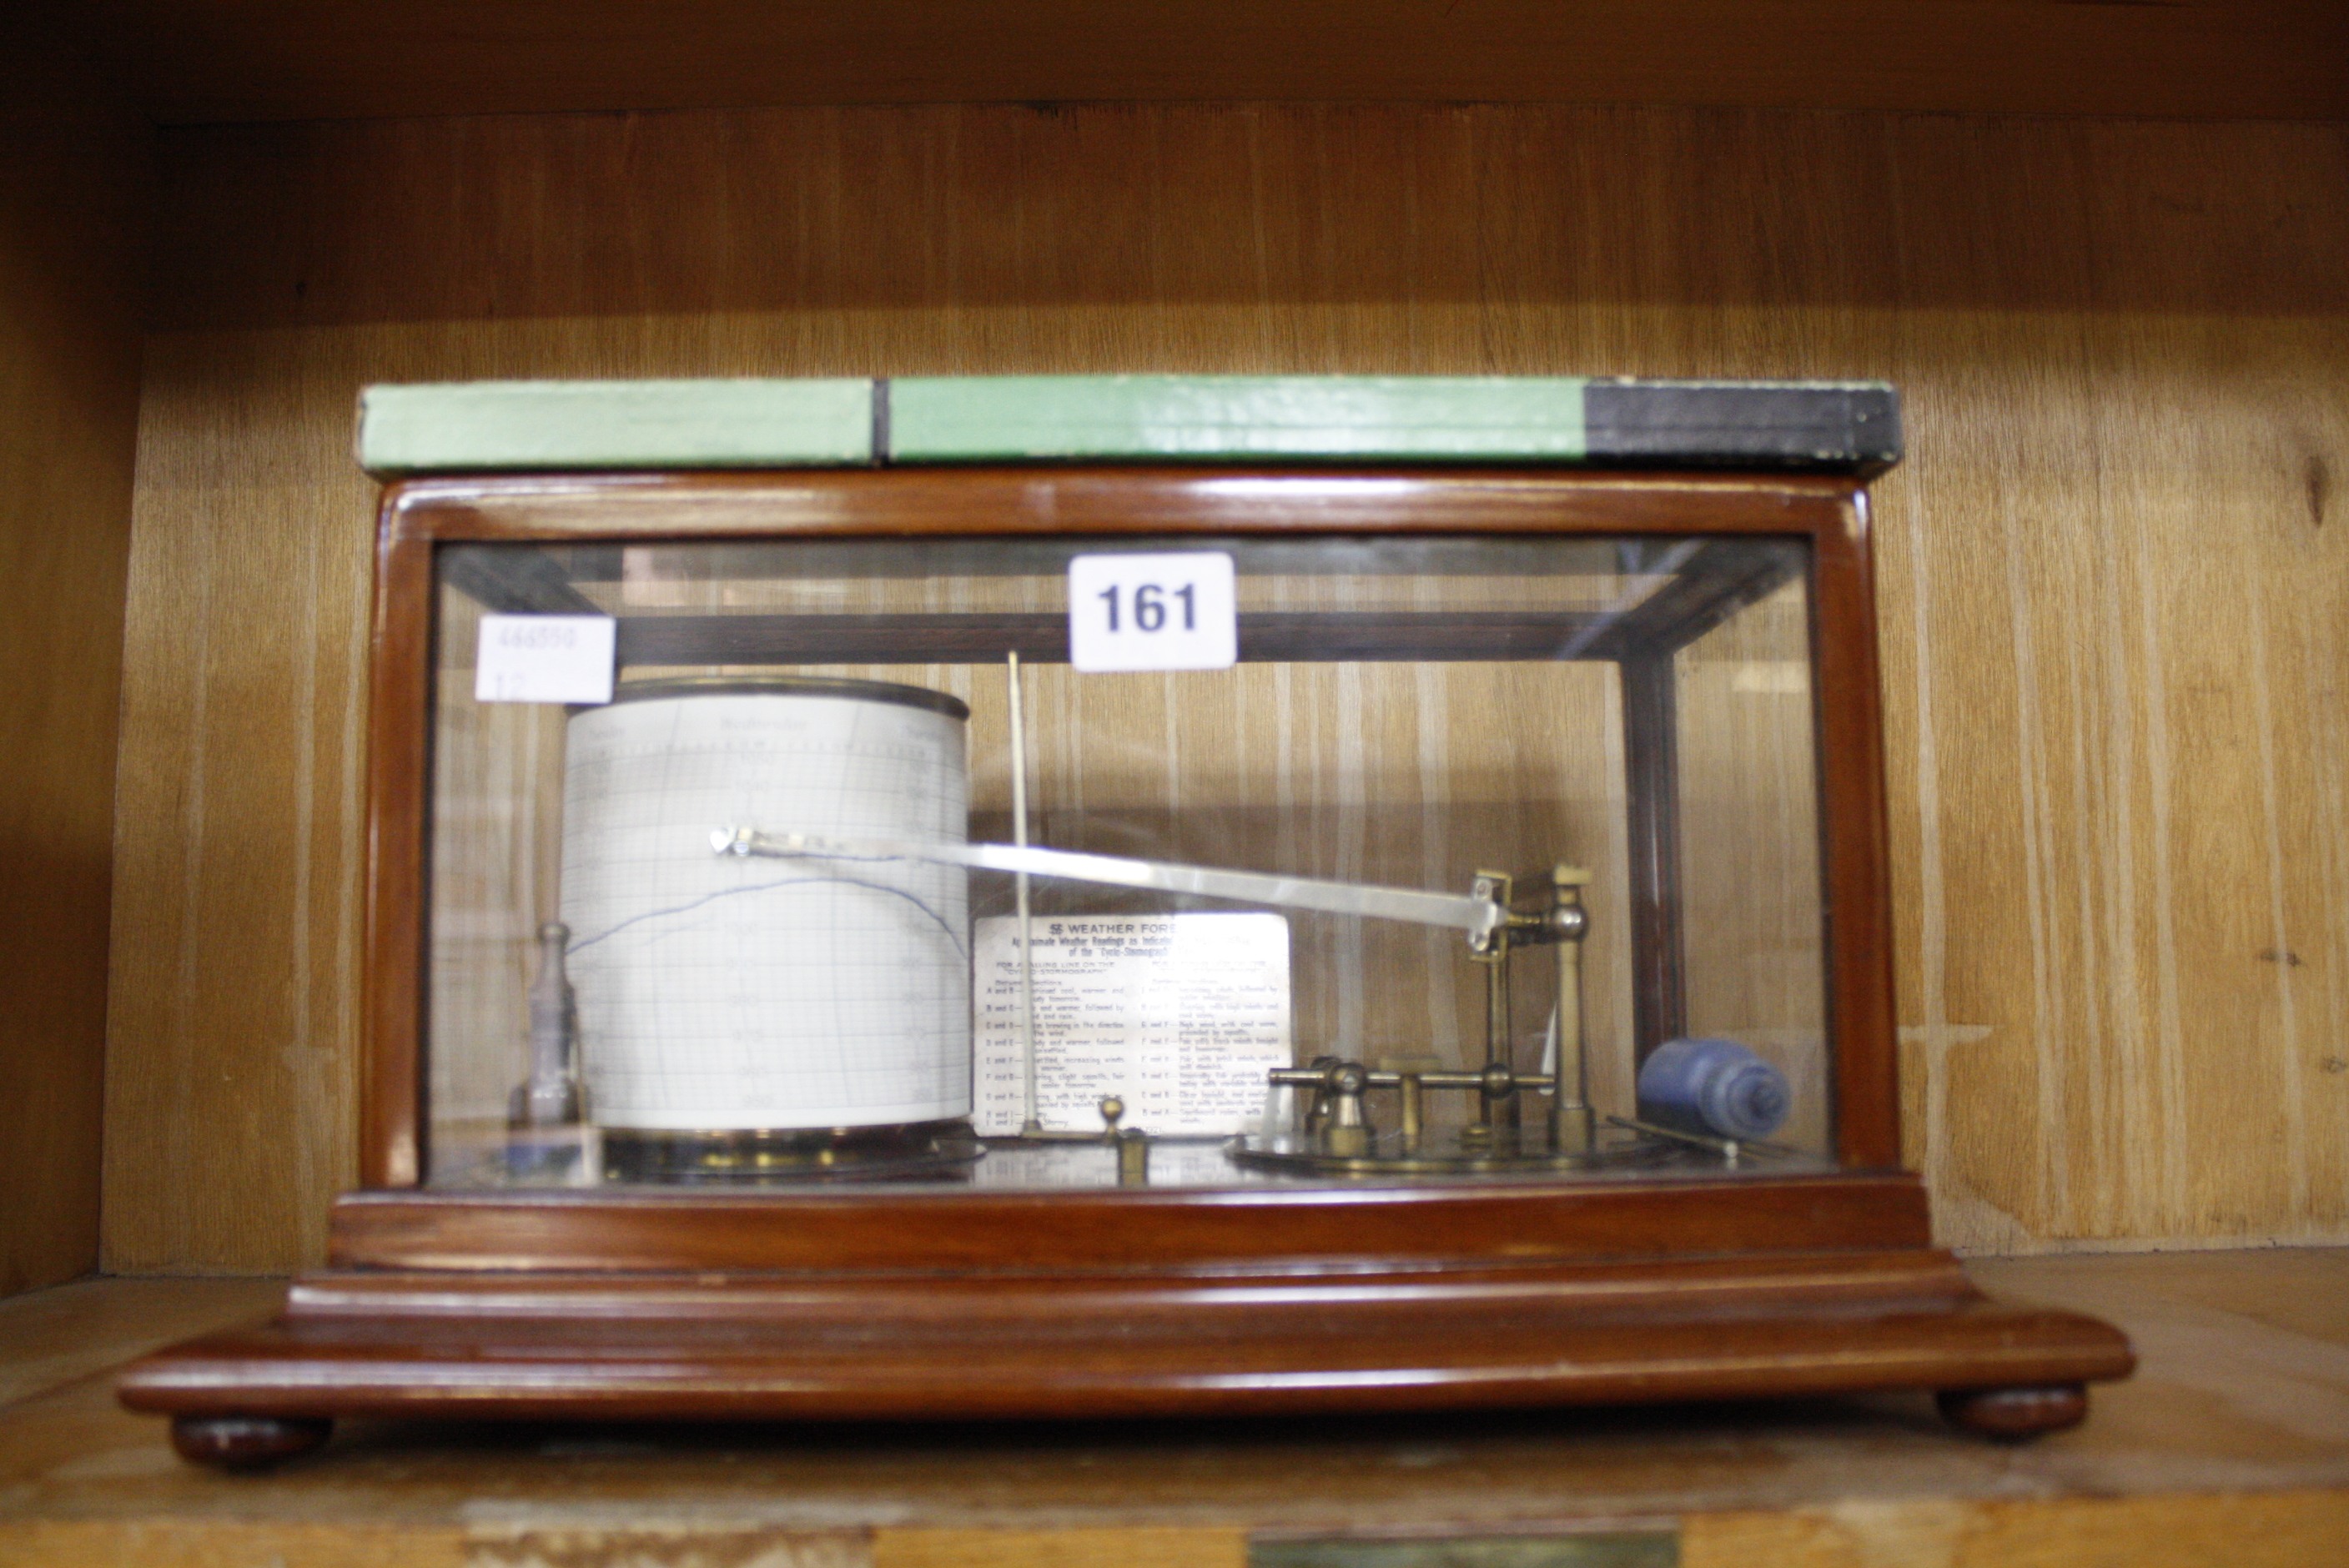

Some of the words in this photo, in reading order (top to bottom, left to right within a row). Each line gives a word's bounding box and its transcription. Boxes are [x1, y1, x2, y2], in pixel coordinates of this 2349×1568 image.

[1099, 583, 1195, 633] 161
[1069, 923, 1135, 935] WEATHER
[1140, 923, 1175, 935] FORE
[1059, 937, 1088, 946] Weather
[1092, 936, 1124, 947] Readings
[1129, 937, 1138, 946] as
[1069, 947, 1077, 957] of
[1081, 947, 1093, 957] the
